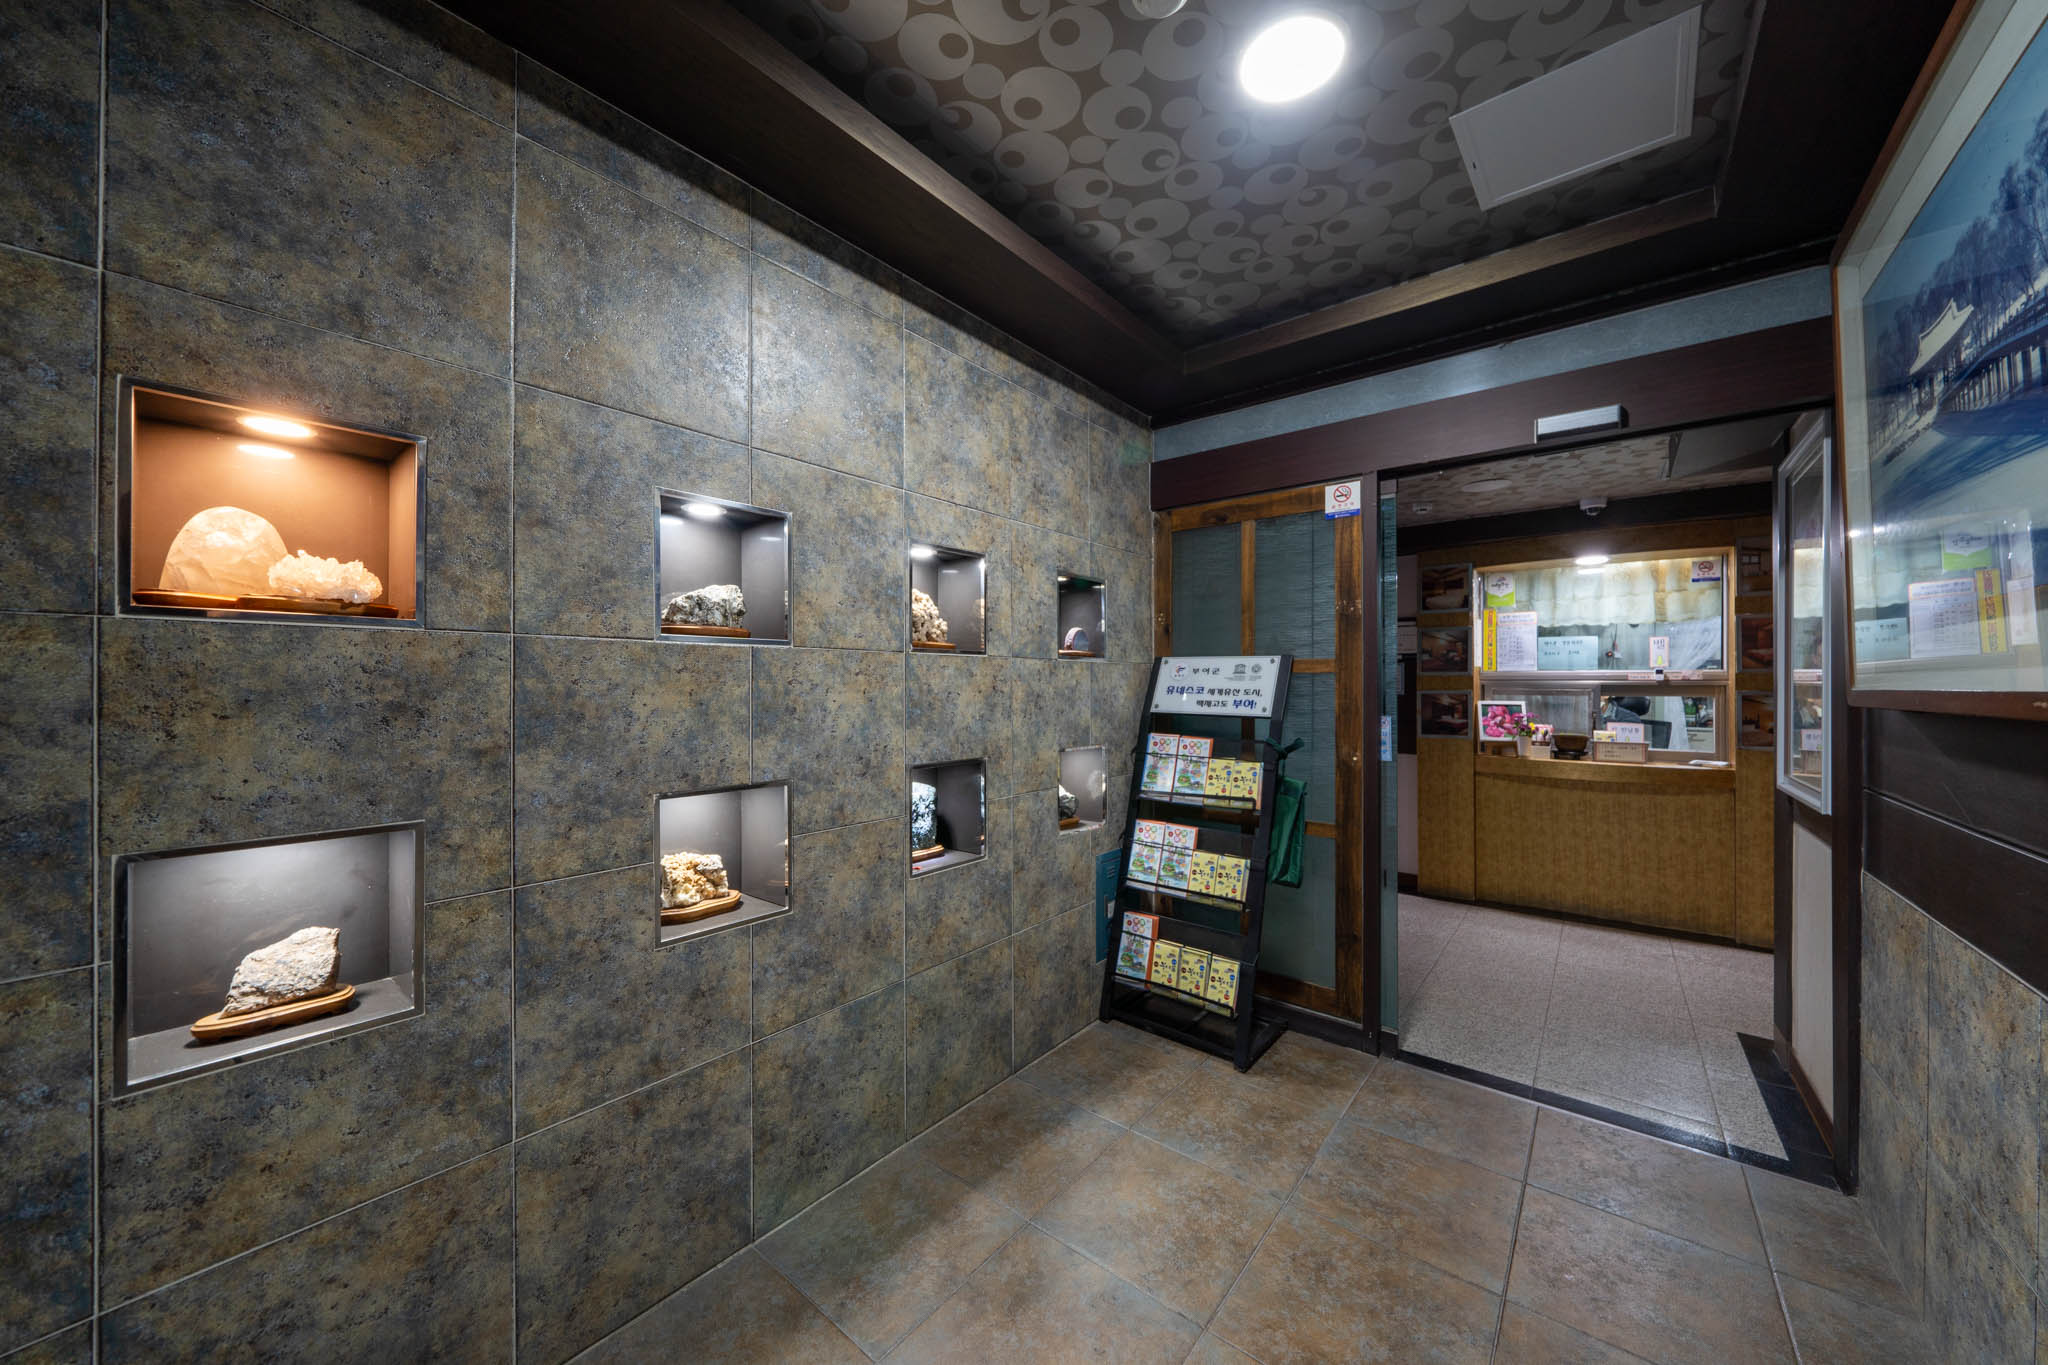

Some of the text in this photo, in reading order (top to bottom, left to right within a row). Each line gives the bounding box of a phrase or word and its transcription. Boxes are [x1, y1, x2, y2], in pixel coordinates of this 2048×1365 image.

[1192, 667, 1220, 675] 부여군
[1166, 685, 1205, 695] 유네스코
[1207, 688, 1240, 697] 세계유산
[1196, 699, 1229, 708] 백제고도
